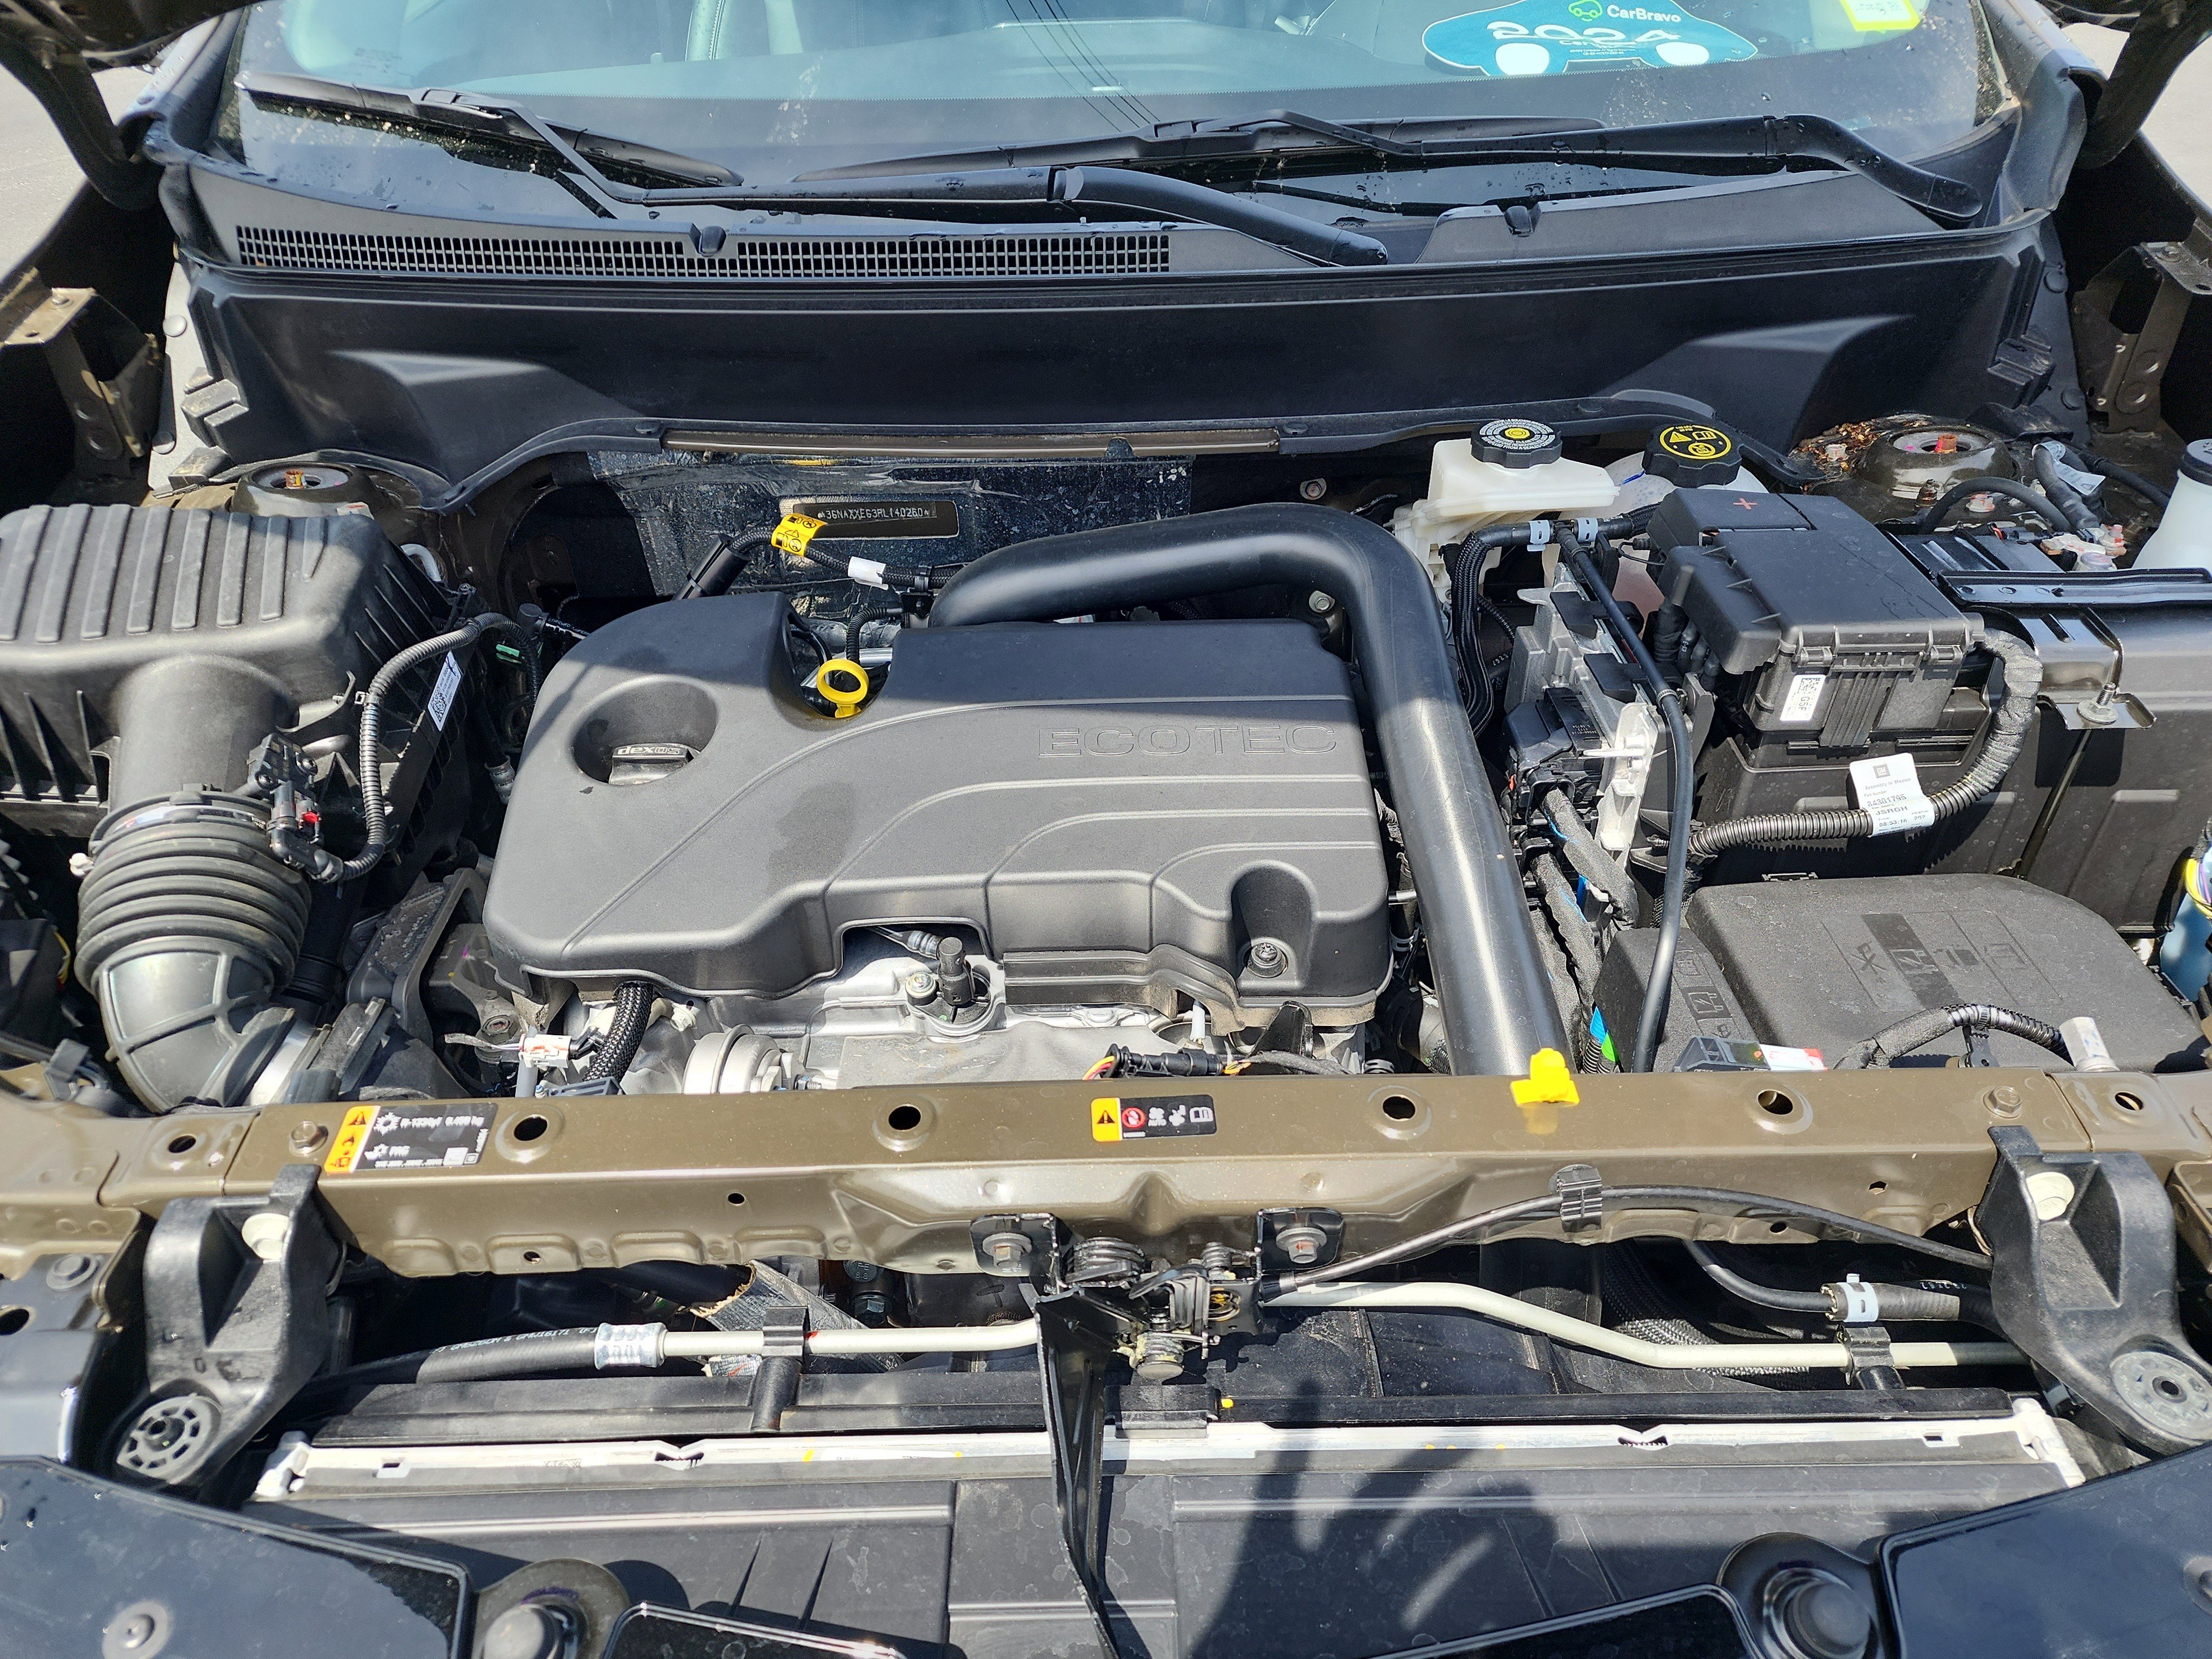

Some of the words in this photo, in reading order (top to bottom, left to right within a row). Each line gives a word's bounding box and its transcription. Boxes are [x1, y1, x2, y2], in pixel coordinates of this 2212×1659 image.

[1607, 4, 1681, 23] CarBravo
[1798, 696, 1811, 712] G5F
[1038, 722, 1337, 758] ECOTEC
[617, 745, 681, 755] dexos
[1879, 818, 1908, 827] 08:53:16
[1147, 1119, 1167, 1127] AUTO
